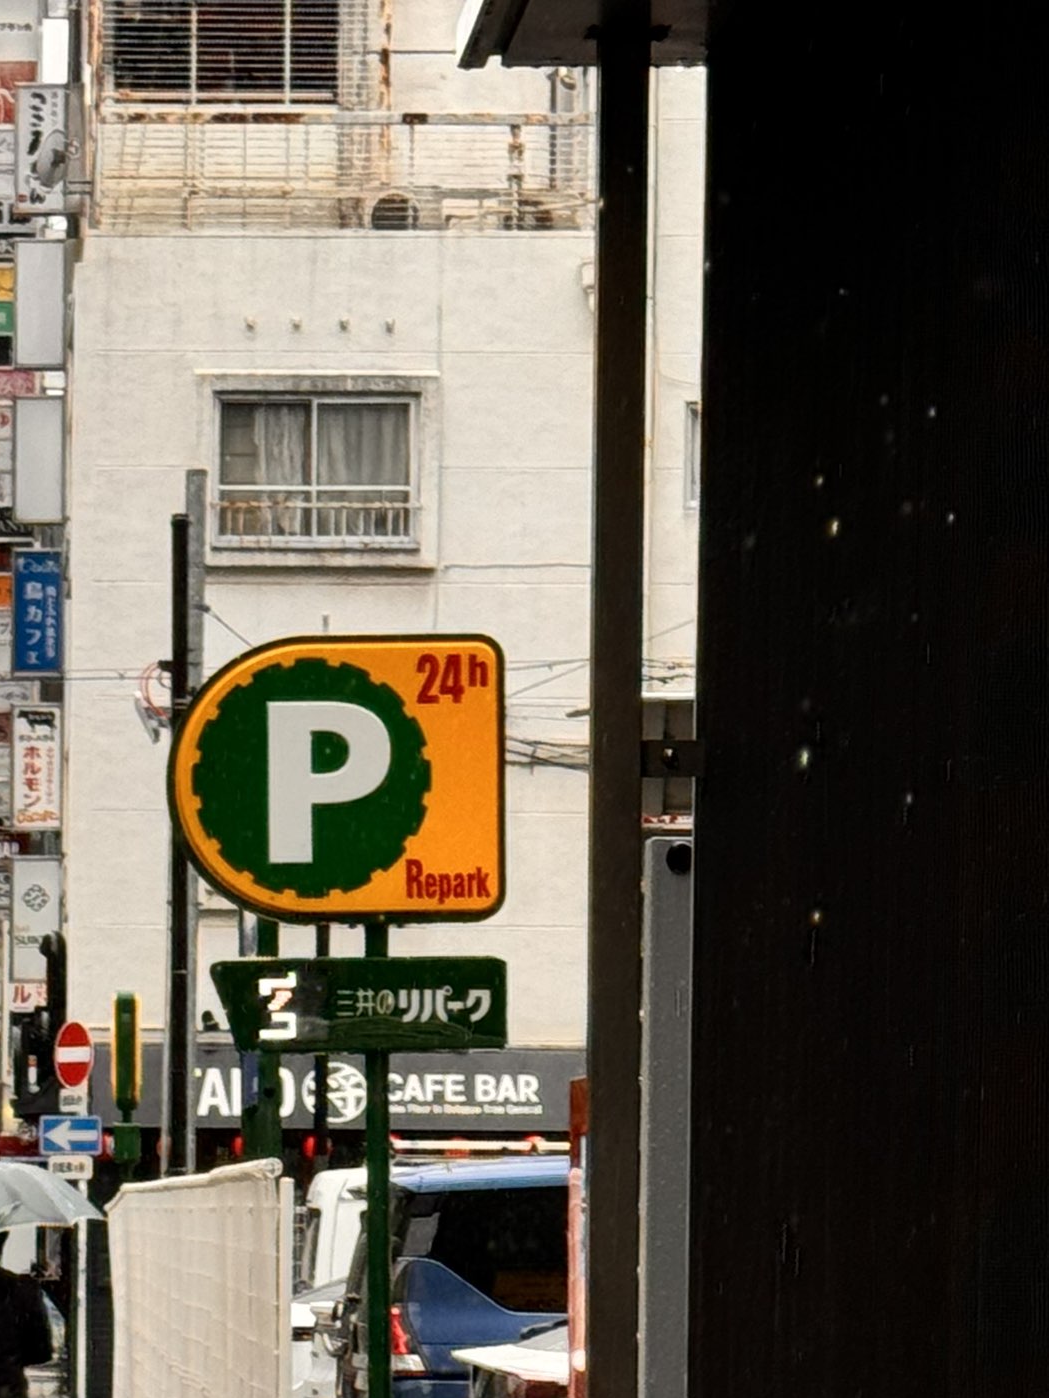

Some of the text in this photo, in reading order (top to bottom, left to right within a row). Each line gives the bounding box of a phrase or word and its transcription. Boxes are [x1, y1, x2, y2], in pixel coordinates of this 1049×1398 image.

[415, 653, 489, 705] 24h
[23, 745, 42, 808] ホルモン
[266, 700, 392, 864] P
[405, 858, 492, 905] Repark
[336, 984, 492, 1023] 三井のリパーク
[388, 1072, 541, 1103] CAFE BAR
